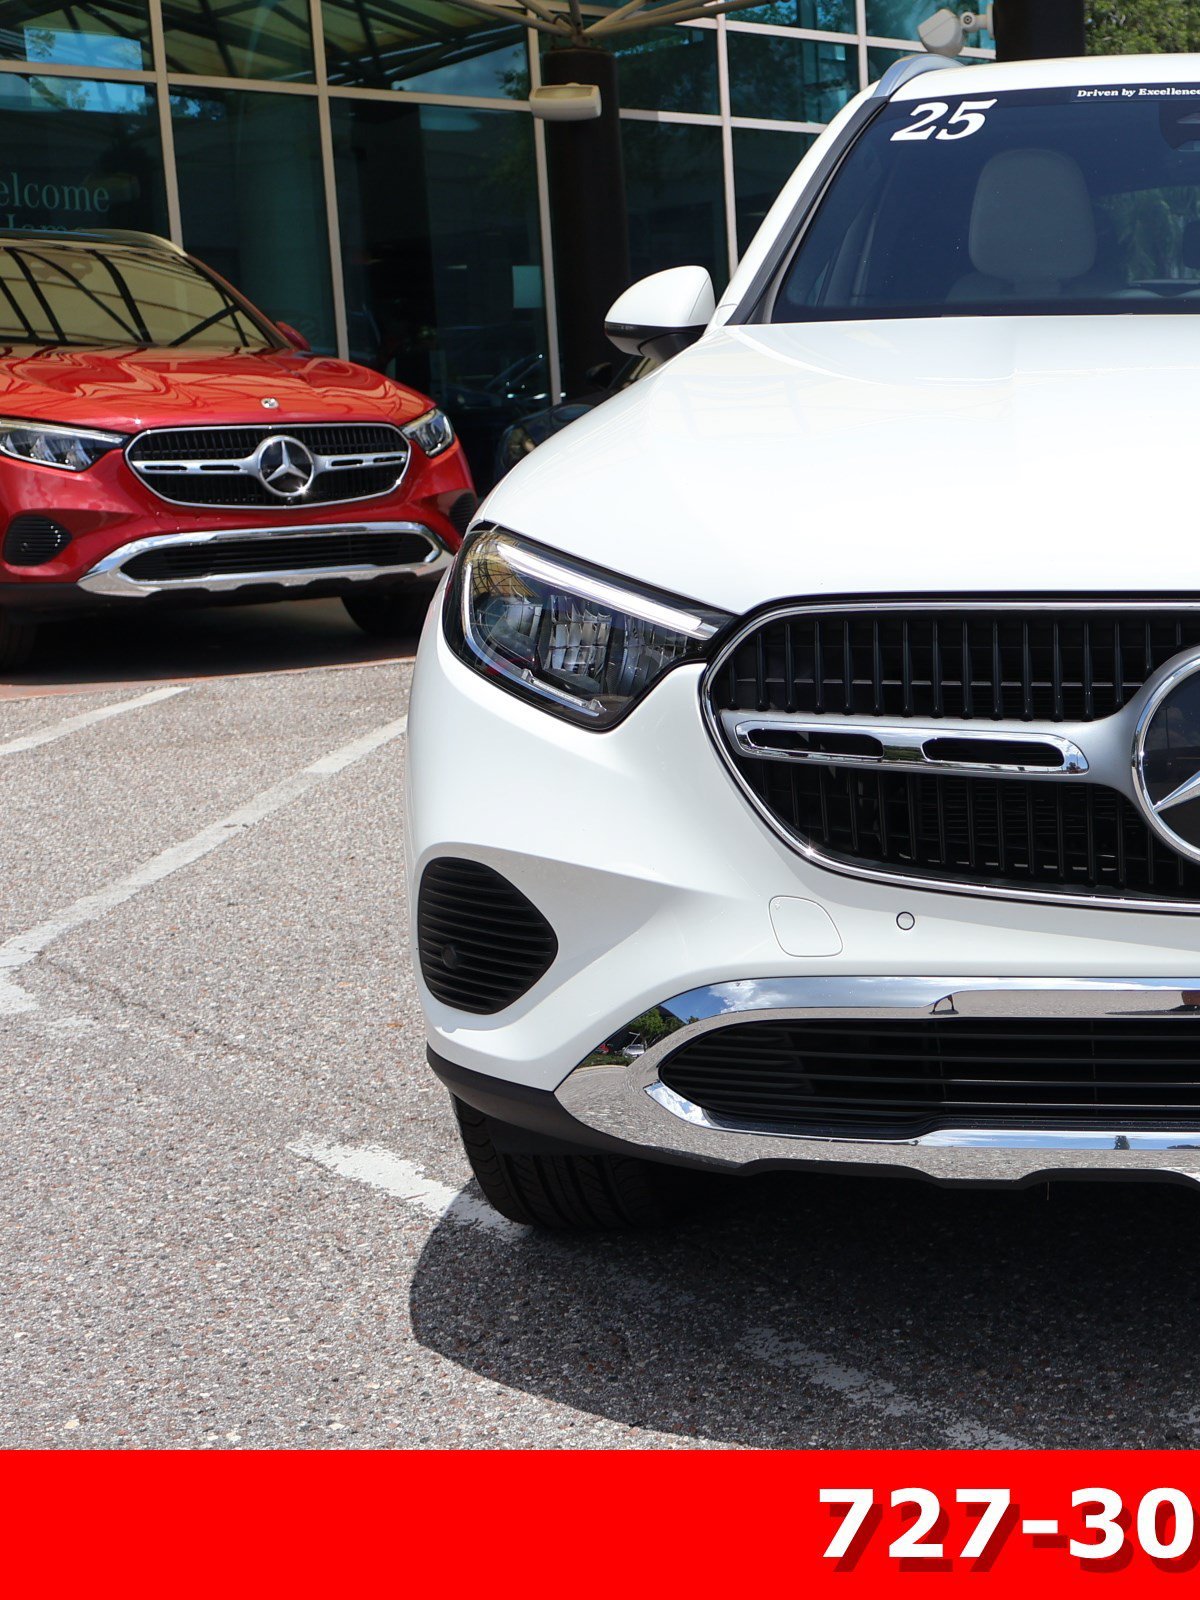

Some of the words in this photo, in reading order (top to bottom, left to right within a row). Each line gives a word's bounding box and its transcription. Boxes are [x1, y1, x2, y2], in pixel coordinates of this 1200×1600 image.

[1076, 89, 1119, 97] Driven
[1121, 88, 1136, 98] by
[889, 98, 998, 141] 25
